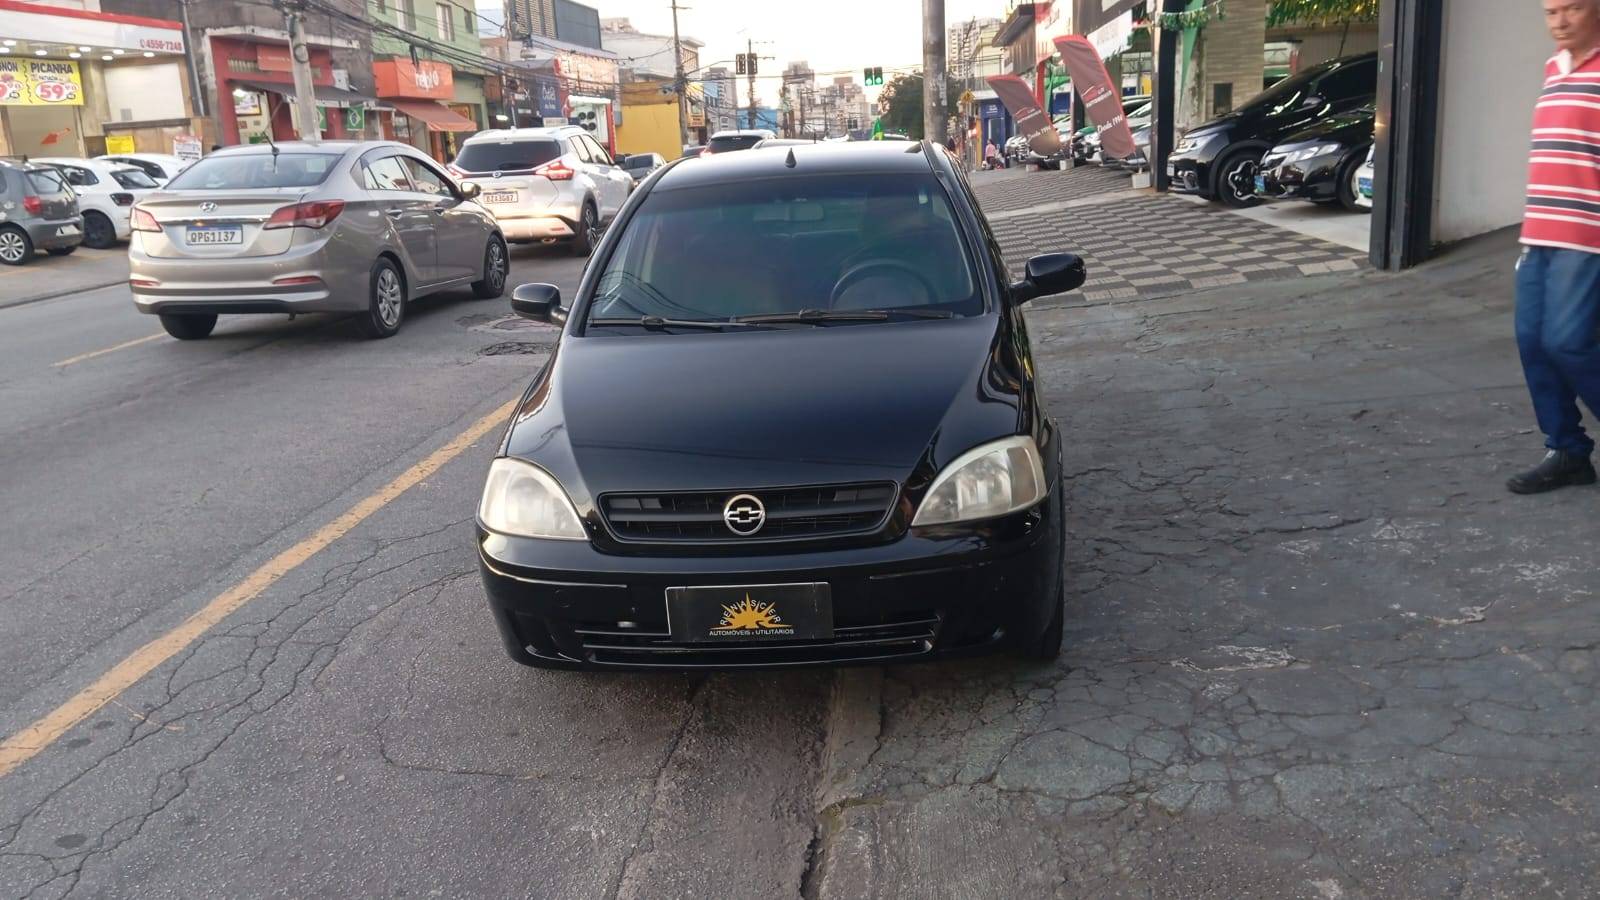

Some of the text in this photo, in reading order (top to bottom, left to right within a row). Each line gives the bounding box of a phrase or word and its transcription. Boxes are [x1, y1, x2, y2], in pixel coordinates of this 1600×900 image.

[31, 62, 73, 74] PICANHA
[40, 85, 64, 98] 59
[720, 600, 781, 626] RENASCER
